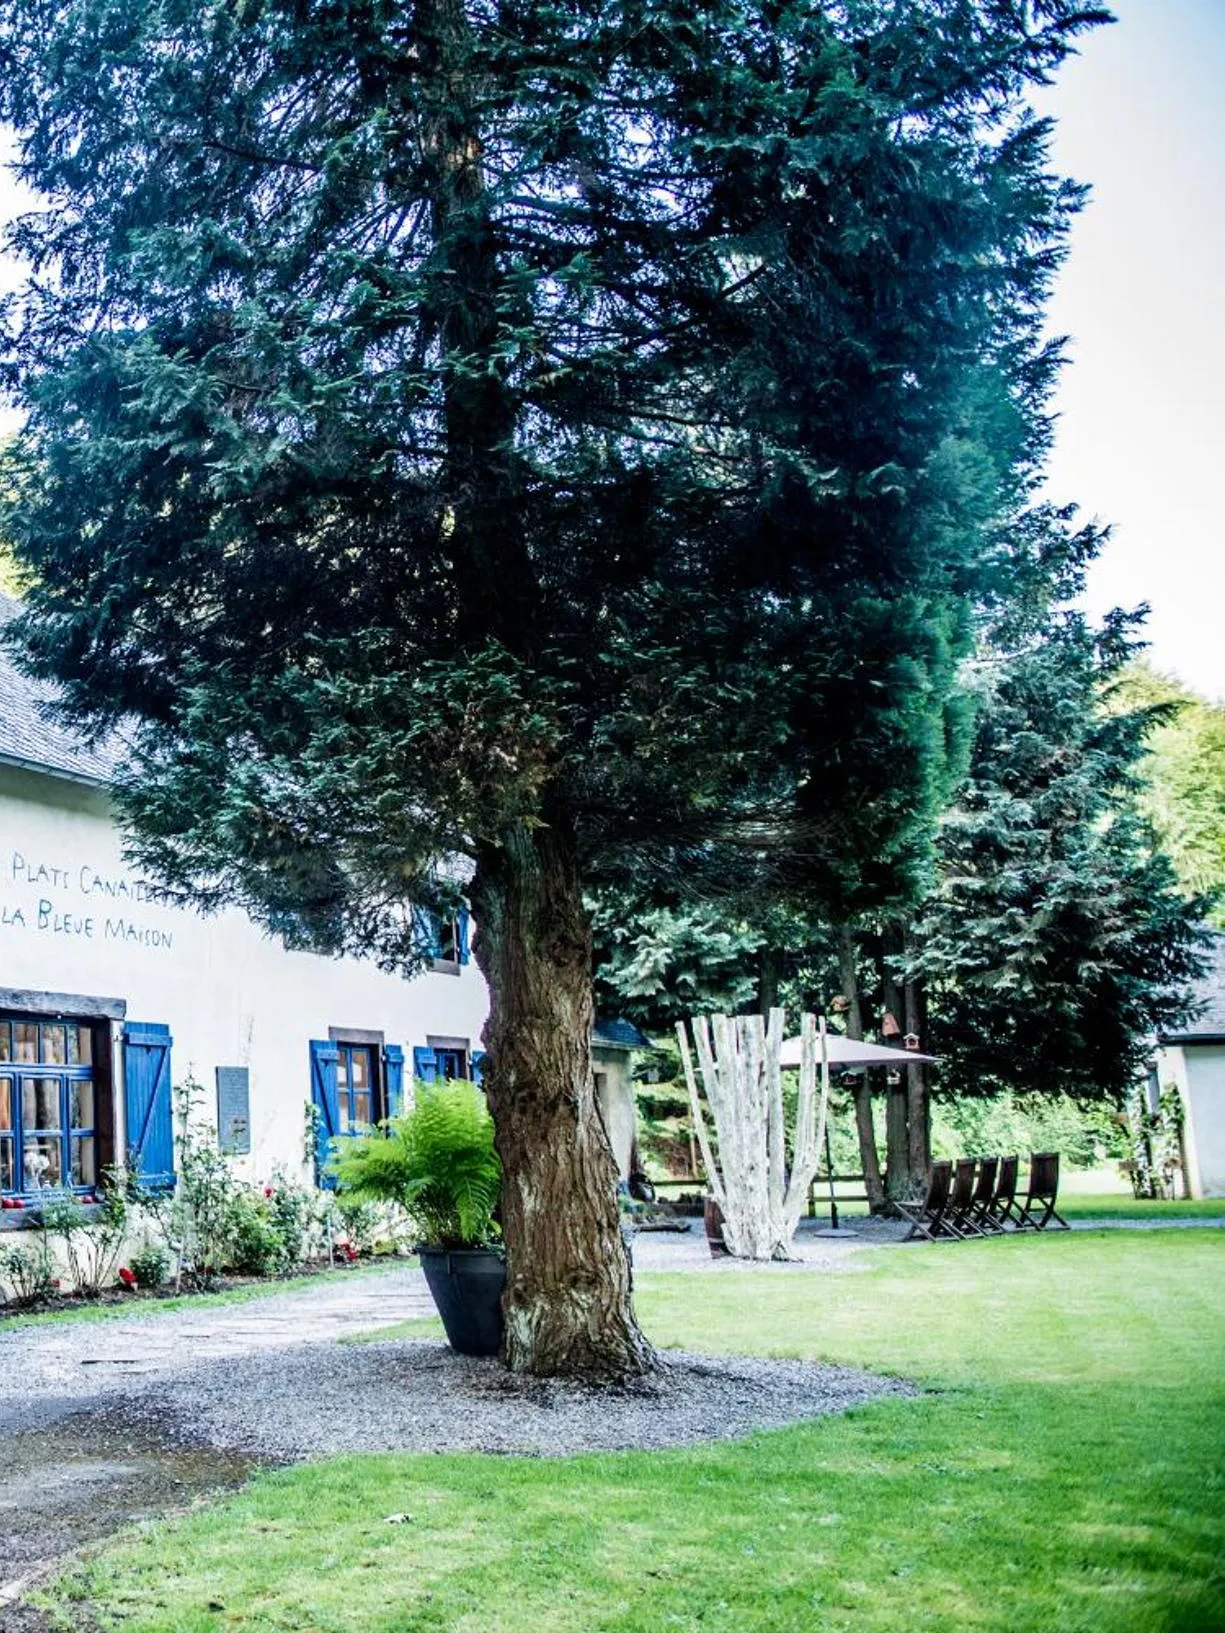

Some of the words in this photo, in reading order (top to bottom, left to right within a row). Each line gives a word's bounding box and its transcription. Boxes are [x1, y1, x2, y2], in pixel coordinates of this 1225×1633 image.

[12, 851, 69, 889] PLATS
[1, 905, 26, 928] LA
[38, 899, 93, 939] BLEUE
